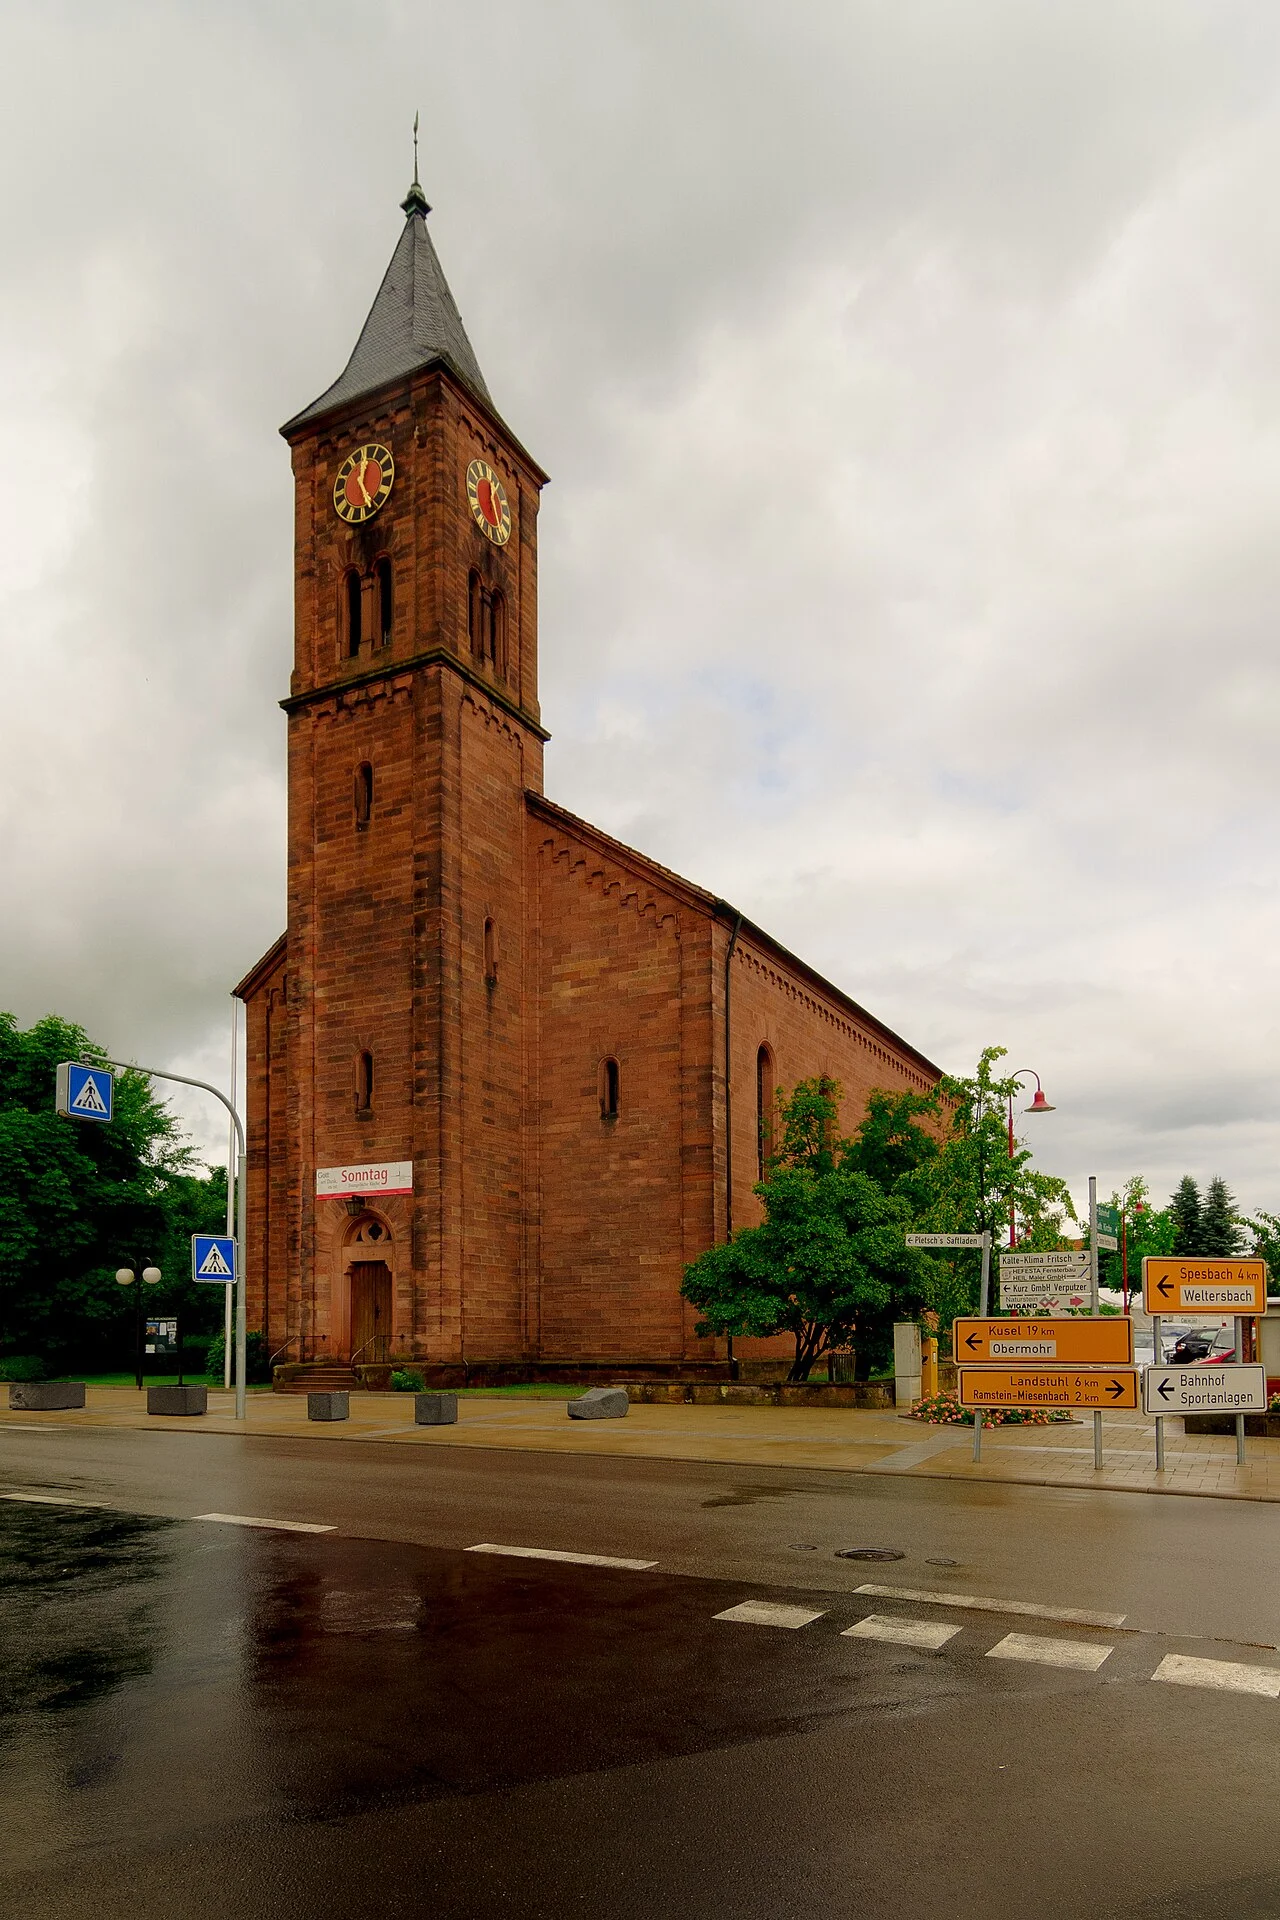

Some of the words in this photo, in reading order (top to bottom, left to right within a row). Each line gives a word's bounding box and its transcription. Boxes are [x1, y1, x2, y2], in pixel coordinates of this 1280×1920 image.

[341, 1168, 388, 1185] Sonntag
[946, 1236, 978, 1245] Saftladen
[1002, 1255, 1044, 1265] Kälte-Klima
[1047, 1254, 1072, 1263] Fritsch
[1180, 1267, 1233, 1282] Spesbach
[1237, 1268, 1244, 1279] 4
[1246, 1271, 1259, 1280] km
[1031, 1284, 1051, 1292] GmbH
[1053, 1283, 1087, 1293] Verputzer
[1184, 1289, 1252, 1302] Weltersbach
[988, 1325, 1022, 1336] Kusel
[1027, 1325, 1039, 1336] 19
[1041, 1327, 1055, 1336] km
[993, 1343, 1052, 1354] Obermohr
[1010, 1376, 1069, 1387] Landstuhl
[1075, 1376, 1082, 1387] 6
[1084, 1379, 1099, 1387] km
[1180, 1374, 1225, 1387] Bahnhof
[973, 1389, 1070, 1402] Ramstein-Miesenbach
[1075, 1391, 1082, 1402] 2
[1084, 1393, 1099, 1402] km
[1180, 1391, 1253, 1407] Sportanlagen
